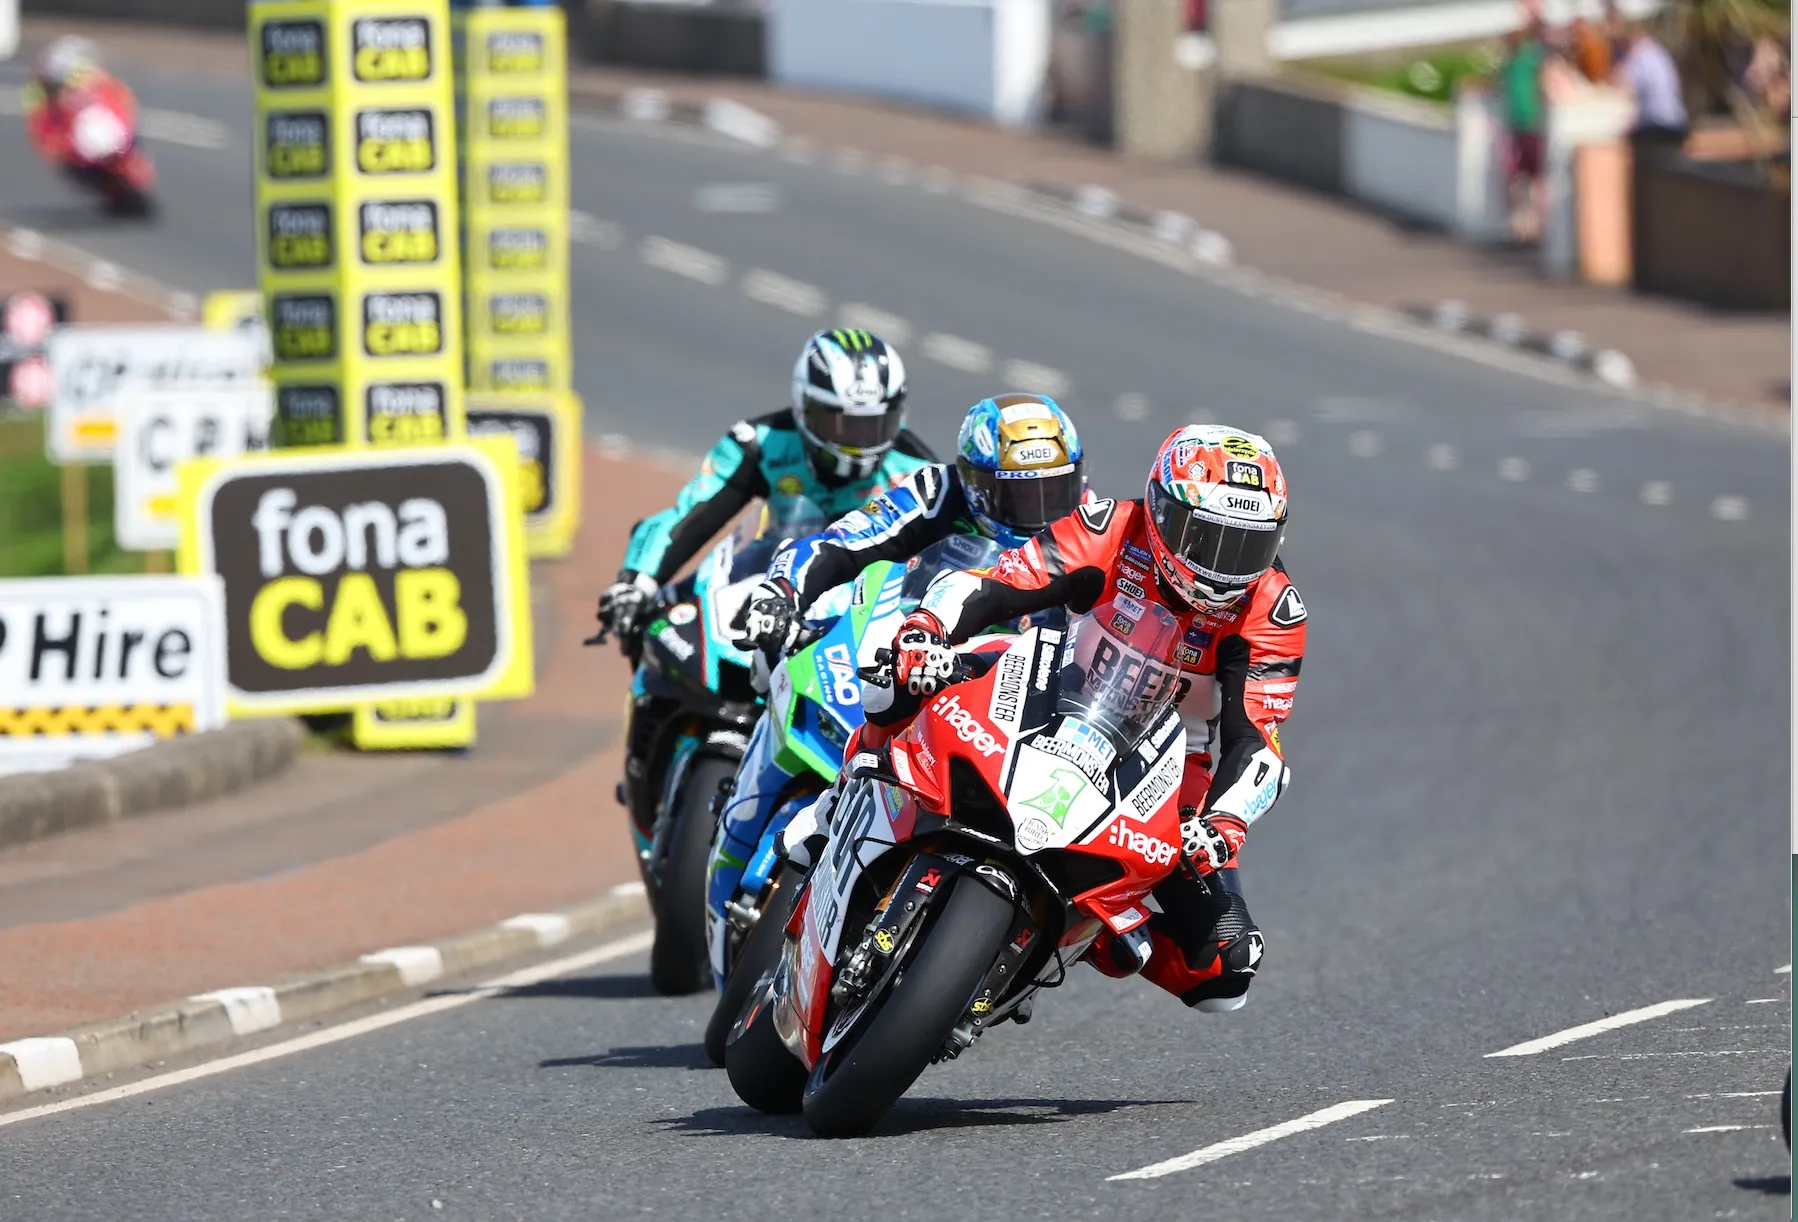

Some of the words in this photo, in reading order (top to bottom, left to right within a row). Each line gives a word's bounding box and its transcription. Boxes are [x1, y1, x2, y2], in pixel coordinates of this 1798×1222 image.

[996, 470, 1038, 478] PRO
[1020, 448, 1052, 461] SHOEI
[1232, 462, 1258, 475] fona
[1231, 471, 1260, 487] CAB
[1226, 496, 1260, 512] SHOEI
[252, 487, 450, 578] fona
[1118, 579, 1144, 599] SHOEI
[248, 568, 468, 670] CAB
[1113, 621, 1130, 634] CAB
[29, 609, 193, 682] Hire
[816, 655, 834, 703] RACING
[824, 643, 861, 706] DAO
[994, 653, 1026, 722] BEERMONSTER
[1030, 734, 1110, 797] BEERMONSTER
[1088, 729, 1115, 762] MET
[1018, 768, 1088, 830] 1
[1131, 757, 1183, 817] BEERMONSTER
